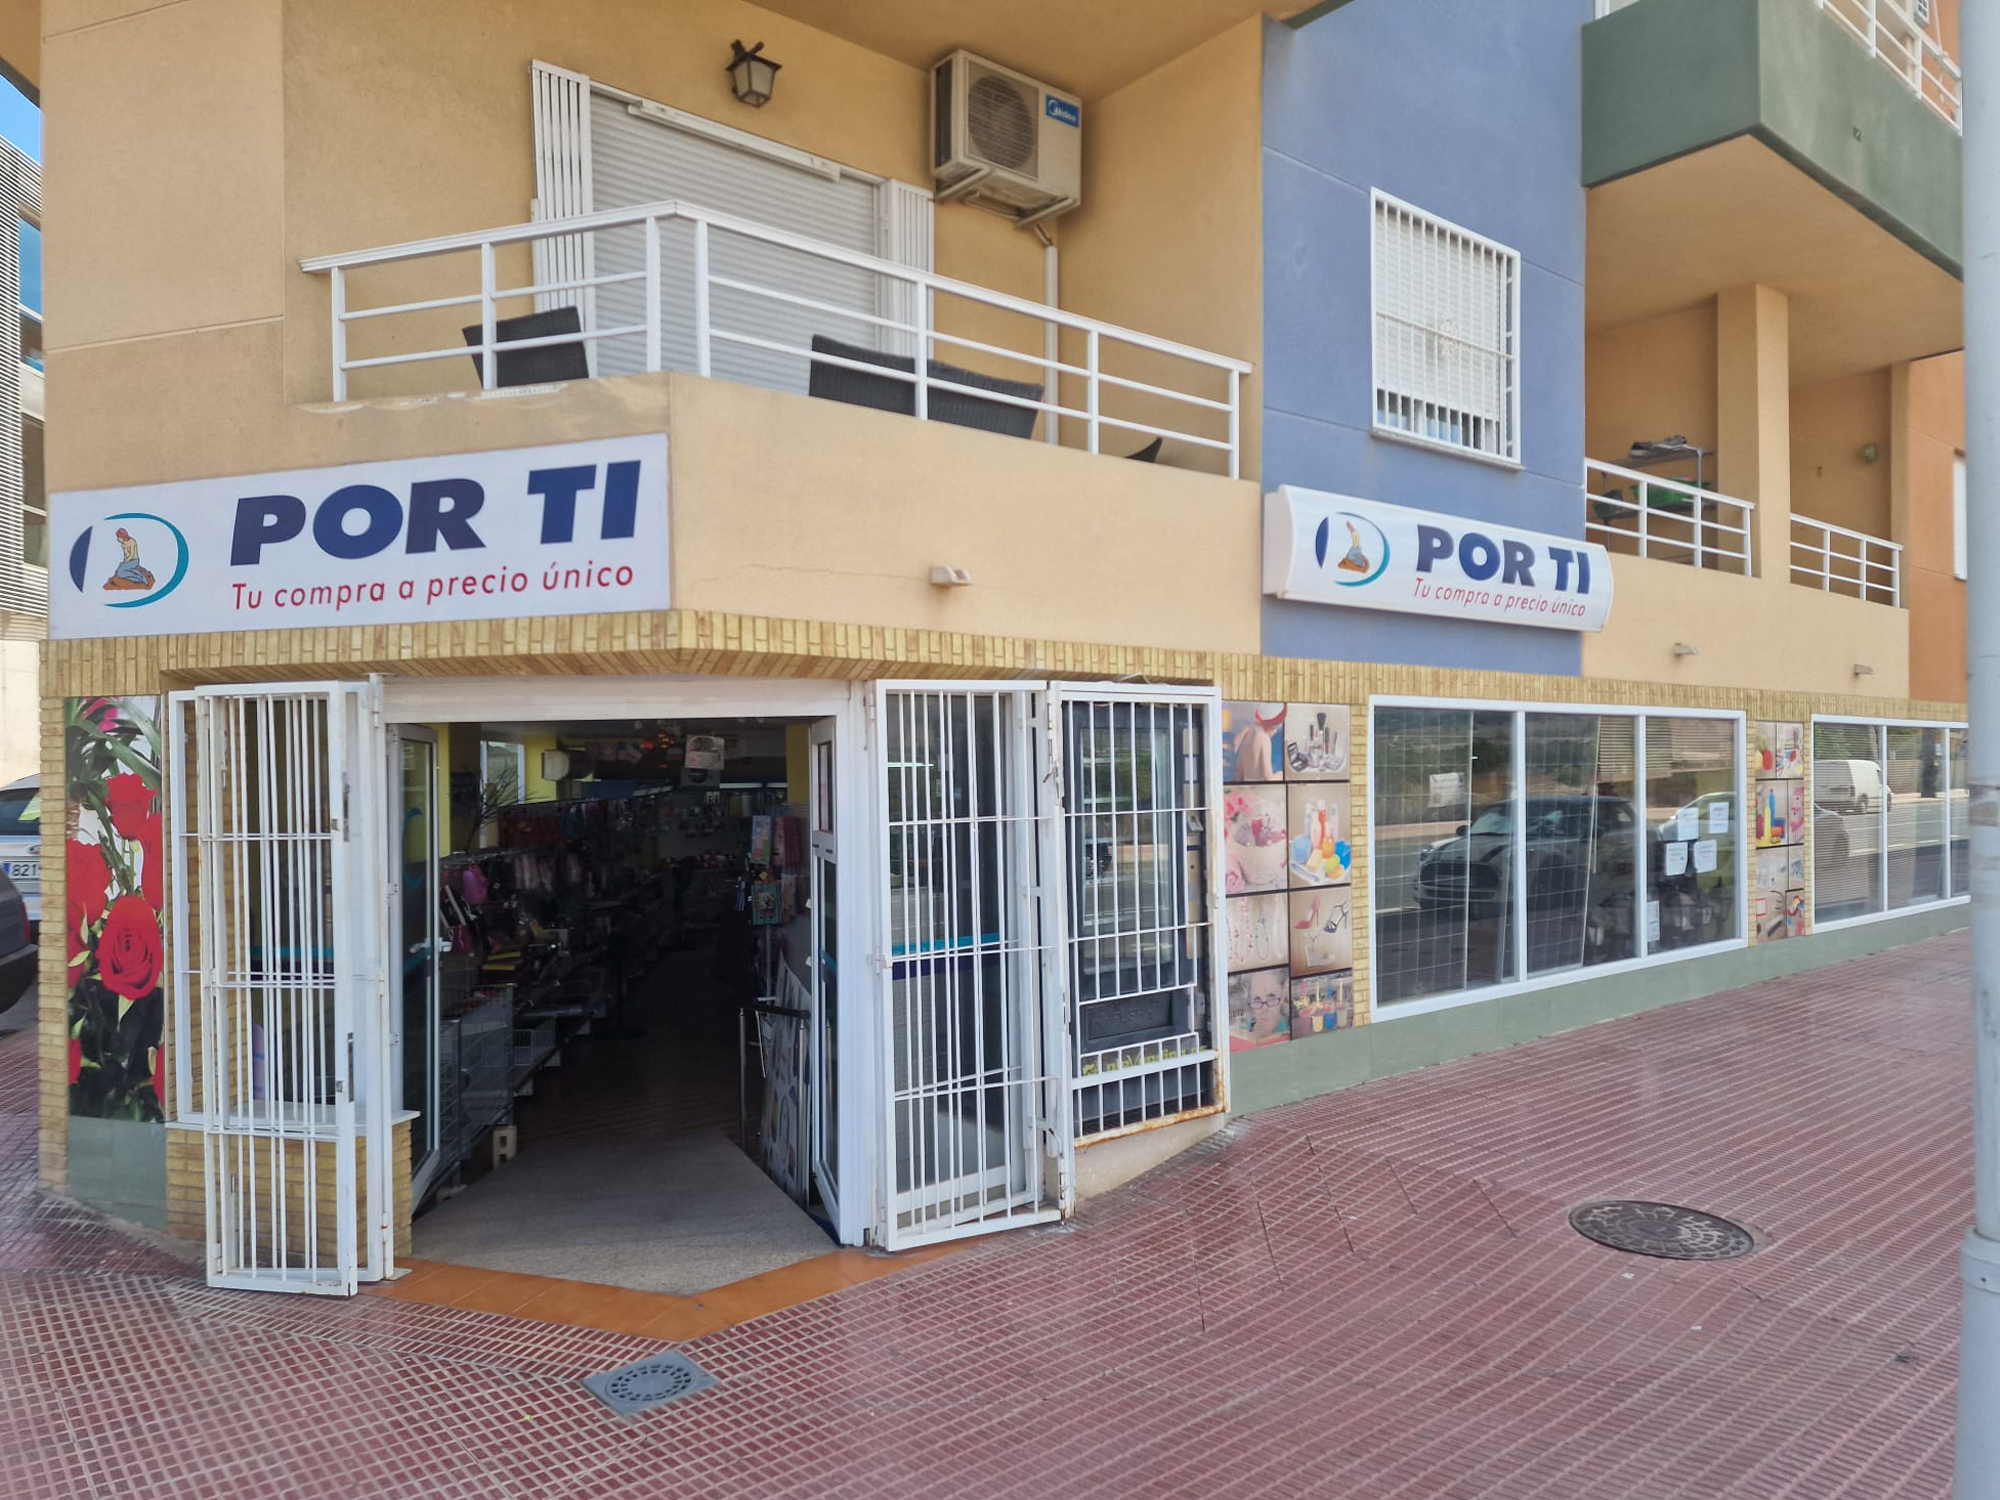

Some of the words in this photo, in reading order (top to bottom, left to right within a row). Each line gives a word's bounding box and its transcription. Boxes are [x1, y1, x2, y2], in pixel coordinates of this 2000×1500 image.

[230, 477, 487, 566] POR
[527, 460, 641, 544] TI
[1416, 524, 1536, 587] POR
[1548, 546, 1591, 594] TI
[232, 583, 262, 610] Tu
[274, 580, 385, 611] compra
[399, 579, 414, 600] a
[426, 565, 528, 605] precio
[542, 560, 634, 591] único
[1413, 577, 1431, 598] Tu
[1435, 585, 1490, 607] compra
[1494, 594, 1503, 607] a
[1504, 593, 1548, 612] precio
[1551, 595, 1586, 617] único
[12, 864, 39, 877] 821
